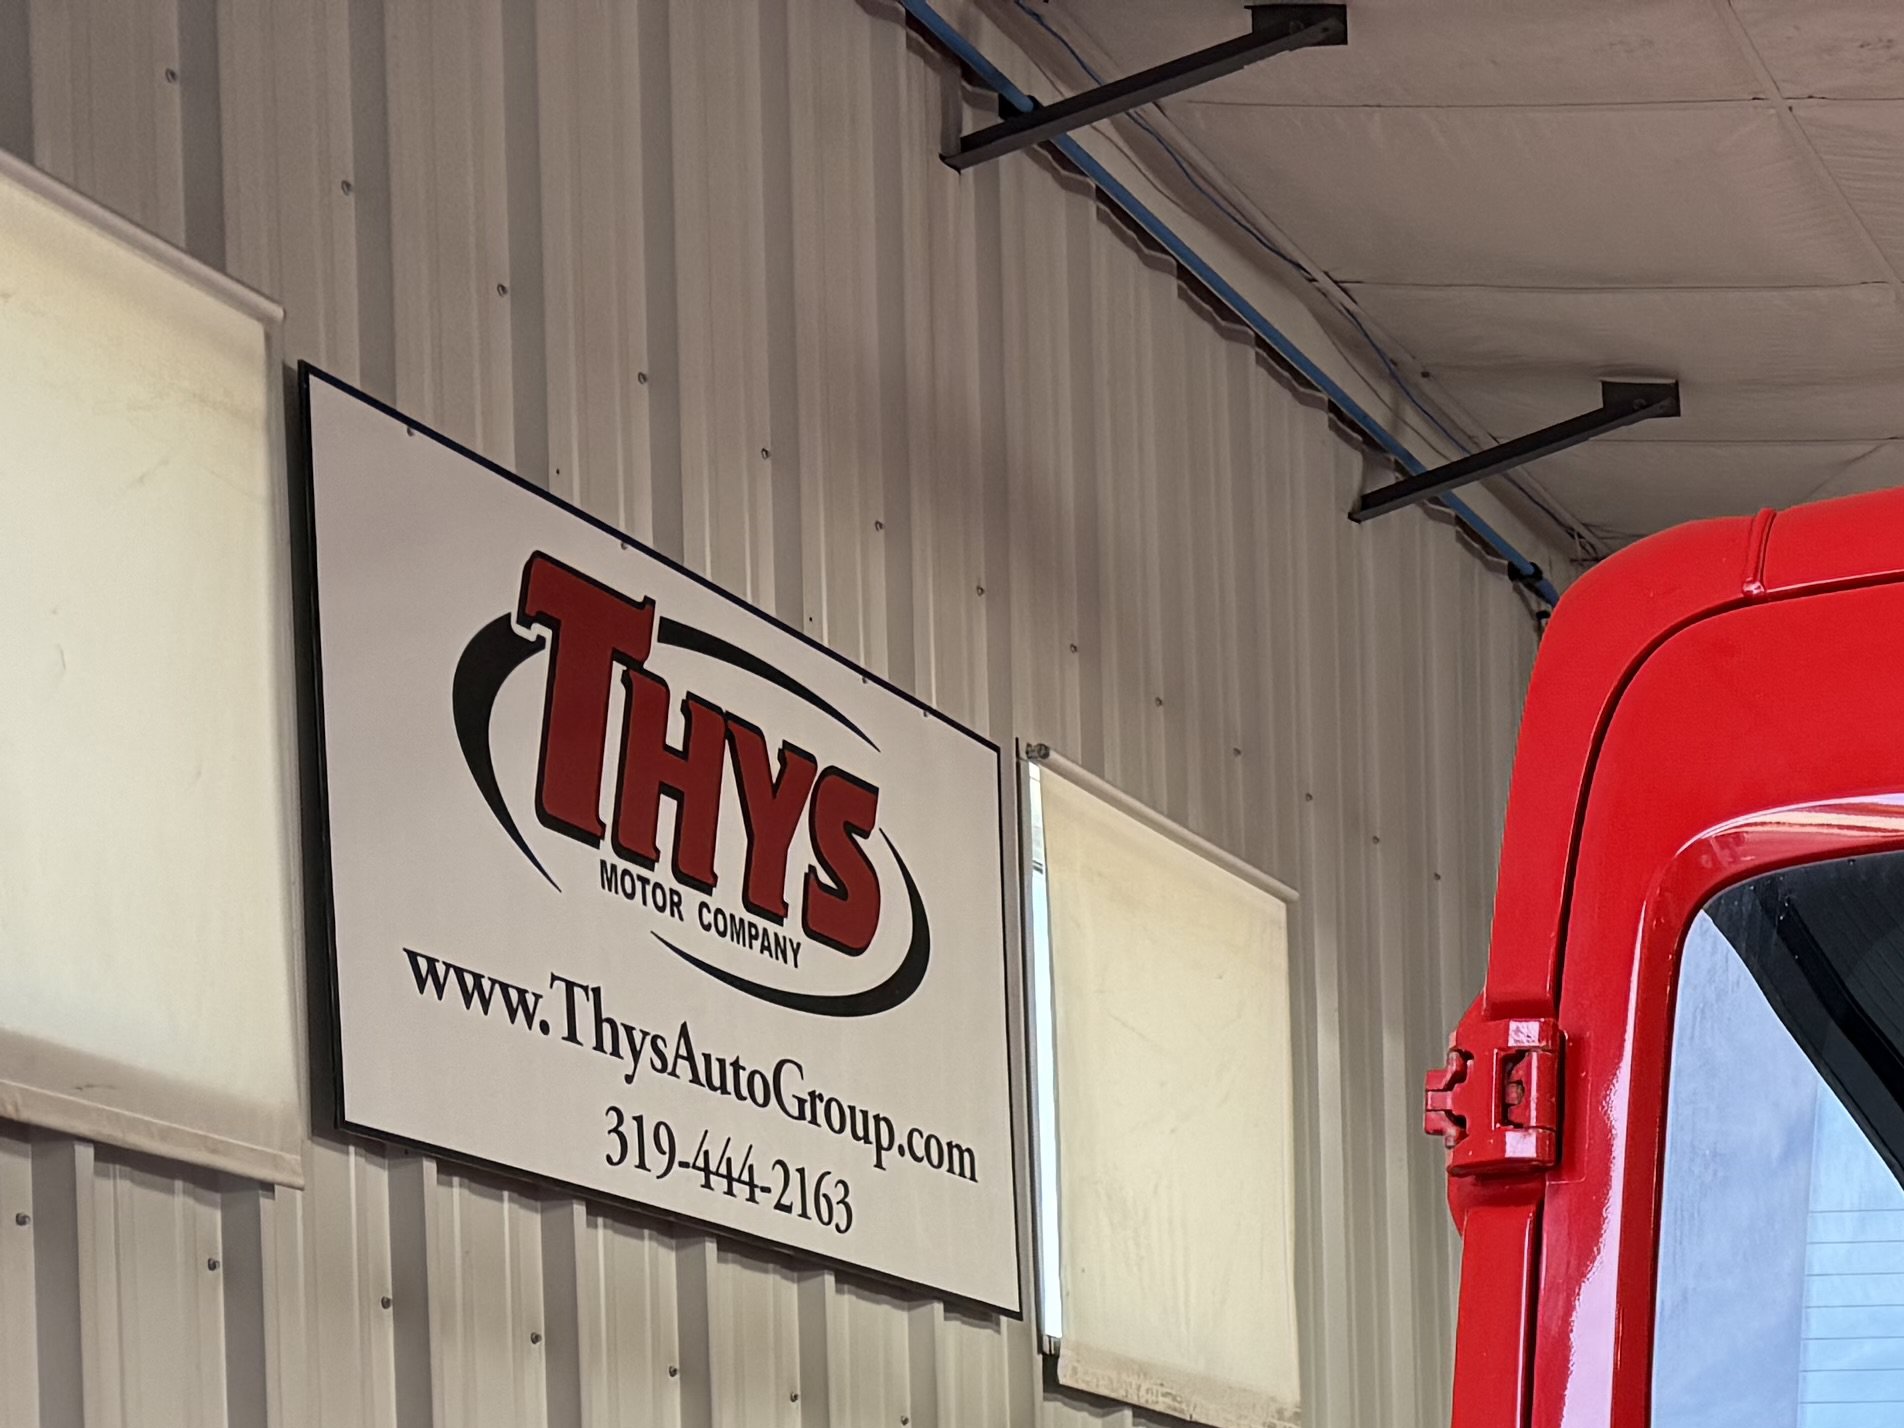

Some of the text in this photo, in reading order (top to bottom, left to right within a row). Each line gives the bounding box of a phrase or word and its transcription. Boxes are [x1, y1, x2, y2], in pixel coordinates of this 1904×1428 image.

[517, 550, 882, 957] THYS
[599, 859, 802, 969] MOTOR COMPANY
[402, 947, 979, 1184] www.ThysAutoGroup.com
[604, 1105, 854, 1235] 319-444-2163
